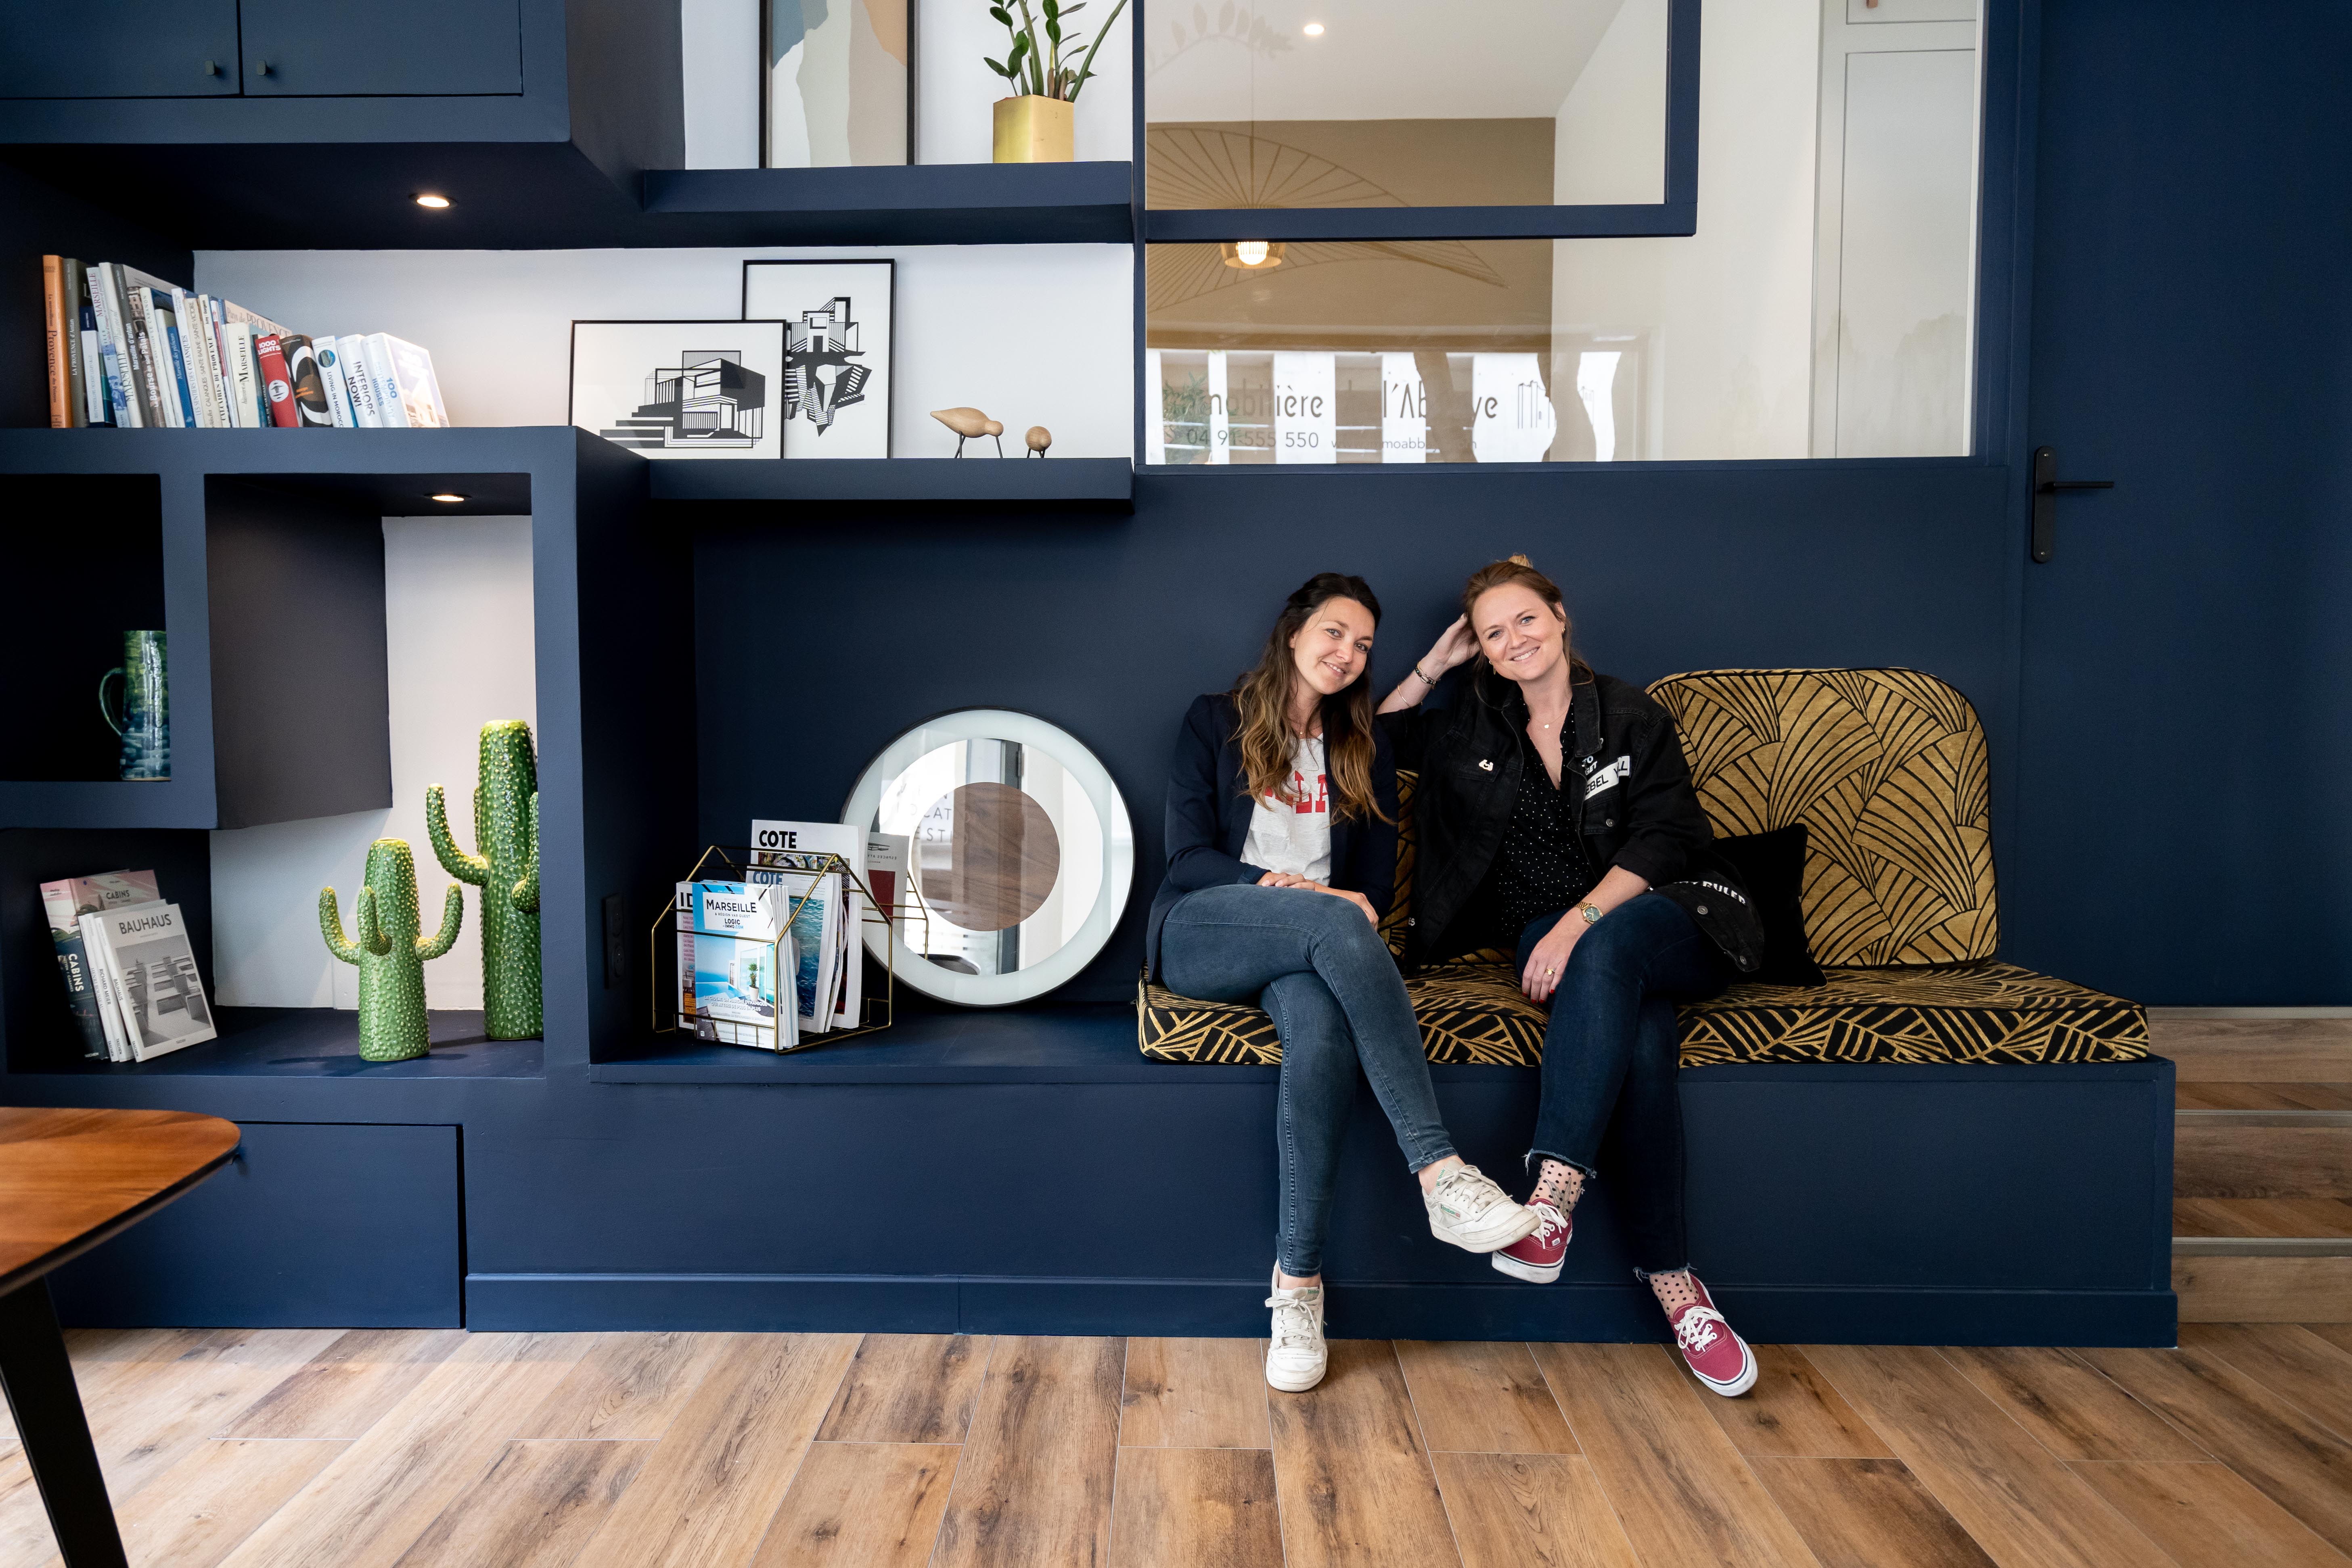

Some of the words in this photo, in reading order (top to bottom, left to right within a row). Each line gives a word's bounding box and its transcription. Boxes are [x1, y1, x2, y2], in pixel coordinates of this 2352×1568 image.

[89, 273, 103, 317] MARSEILLE
[143, 295, 152, 324] CABANON
[188, 301, 197, 322] VICTOIRE
[126, 323, 135, 344] d'antan
[138, 332, 149, 354] Palais
[259, 340, 276, 349] 1000
[48, 330, 57, 375] Provence
[129, 345, 140, 370] Marseille
[182, 335, 193, 370] CALANQUES
[207, 336, 218, 370] PROVENCE
[239, 336, 249, 383] MARSEILLE
[258, 345, 281, 355] LIGHTS
[117, 350, 134, 401] MARSEILLE
[175, 360, 183, 379] Marseille
[213, 373, 219, 381] DE
[147, 372, 157, 401] Bourse
[202, 377, 211, 407] CALANQUES
[327, 371, 335, 391] LIVING
[348, 376, 362, 407] NOW!
[353, 361, 375, 417] INTERIORS
[386, 377, 397, 399] 100
[191, 384, 199, 406] SENTIERS
[372, 378, 384, 407] HOUSES
[1187, 429, 1210, 445] 04
[1218, 430, 1237, 446] 91
[1245, 431, 1276, 447] 555
[1285, 432, 1319, 448] 550
[1585, 761, 1597, 776] GET
[1585, 774, 1609, 796] EBEL
[759, 830, 797, 849] COTE
[753, 871, 784, 886] COTE
[106, 890, 130, 899] CABINS
[1702, 881, 1746, 905] RULER
[706, 899, 757, 913] MARSEILLE
[119, 914, 172, 934] BAUHAUS
[68, 953, 84, 991] CABINS
[113, 978, 123, 1001] BAUHAUS
[1441, 1204, 1456, 1215] Reebok
